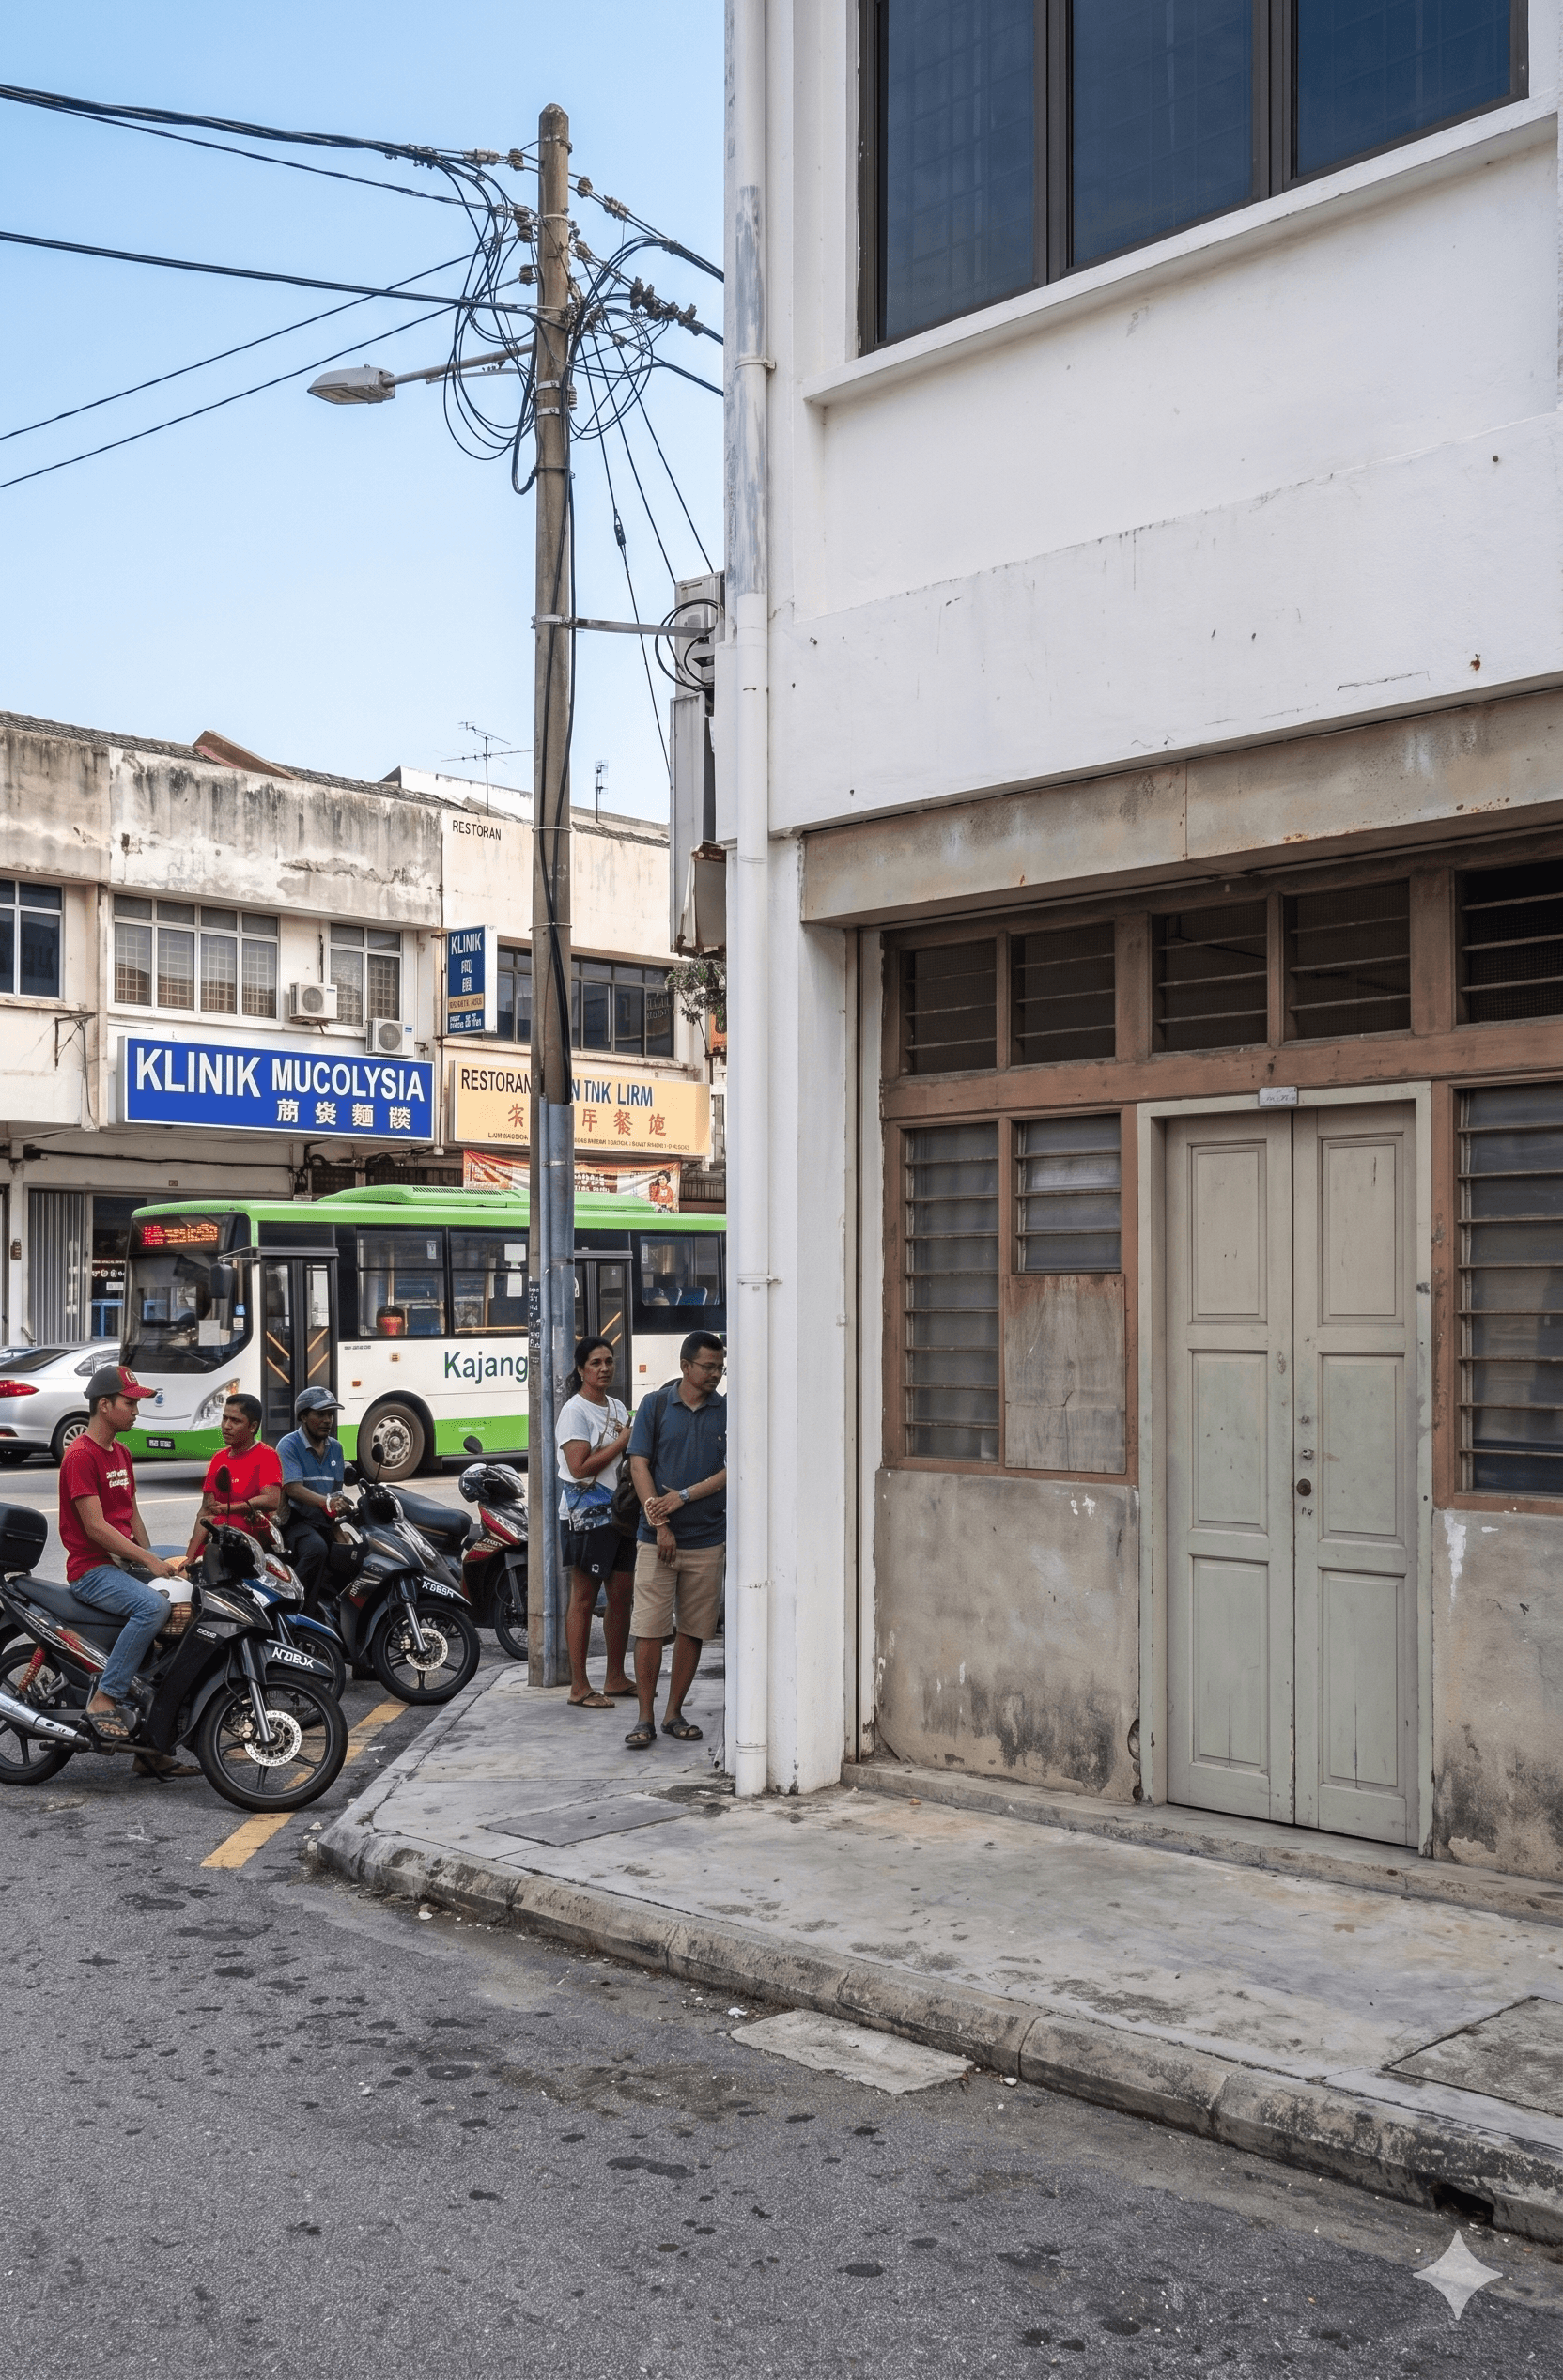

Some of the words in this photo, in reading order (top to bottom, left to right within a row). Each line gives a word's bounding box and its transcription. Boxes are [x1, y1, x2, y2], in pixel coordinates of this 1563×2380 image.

[452, 819, 502, 841] RESTORAN
[451, 932, 482, 955] KLINIK
[136, 1047, 261, 1098] KLINIK
[271, 1058, 426, 1102] MUCOLYSIA
[461, 1068, 532, 1094] RESTORAN
[584, 1080, 611, 1104] TNK
[617, 1083, 653, 1107] LIRM
[444, 1351, 528, 1384] Kajang
